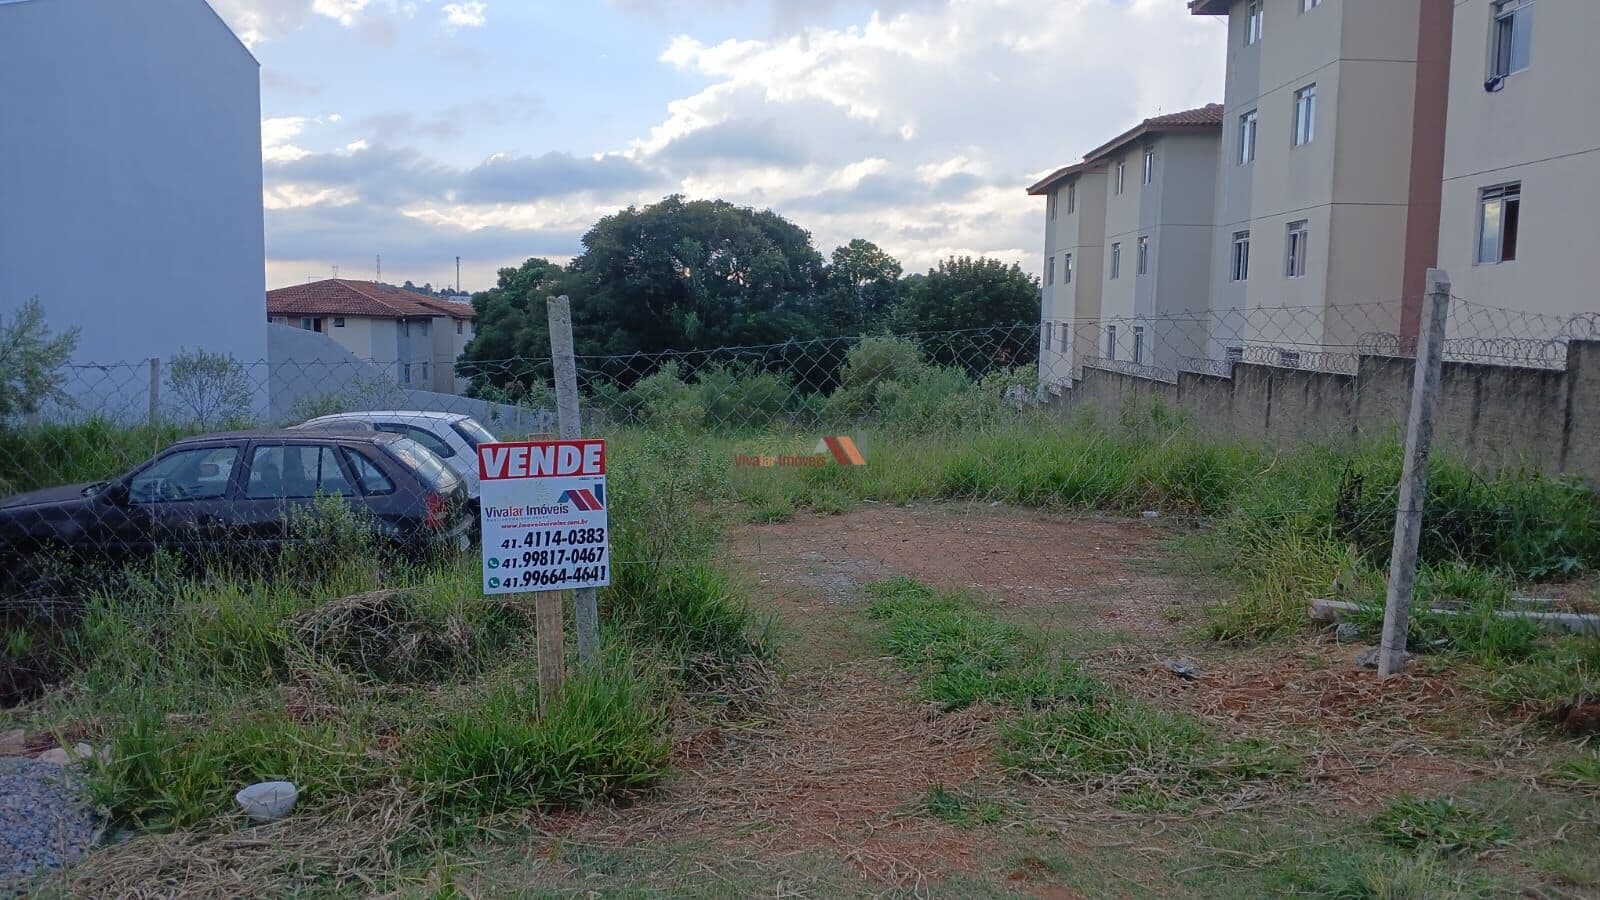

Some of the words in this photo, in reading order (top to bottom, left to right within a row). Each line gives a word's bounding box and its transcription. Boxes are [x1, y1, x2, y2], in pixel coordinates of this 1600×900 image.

[481, 443, 602, 478] VENDE
[485, 506, 524, 518] Vivalar
[526, 504, 569, 516] Imóveis
